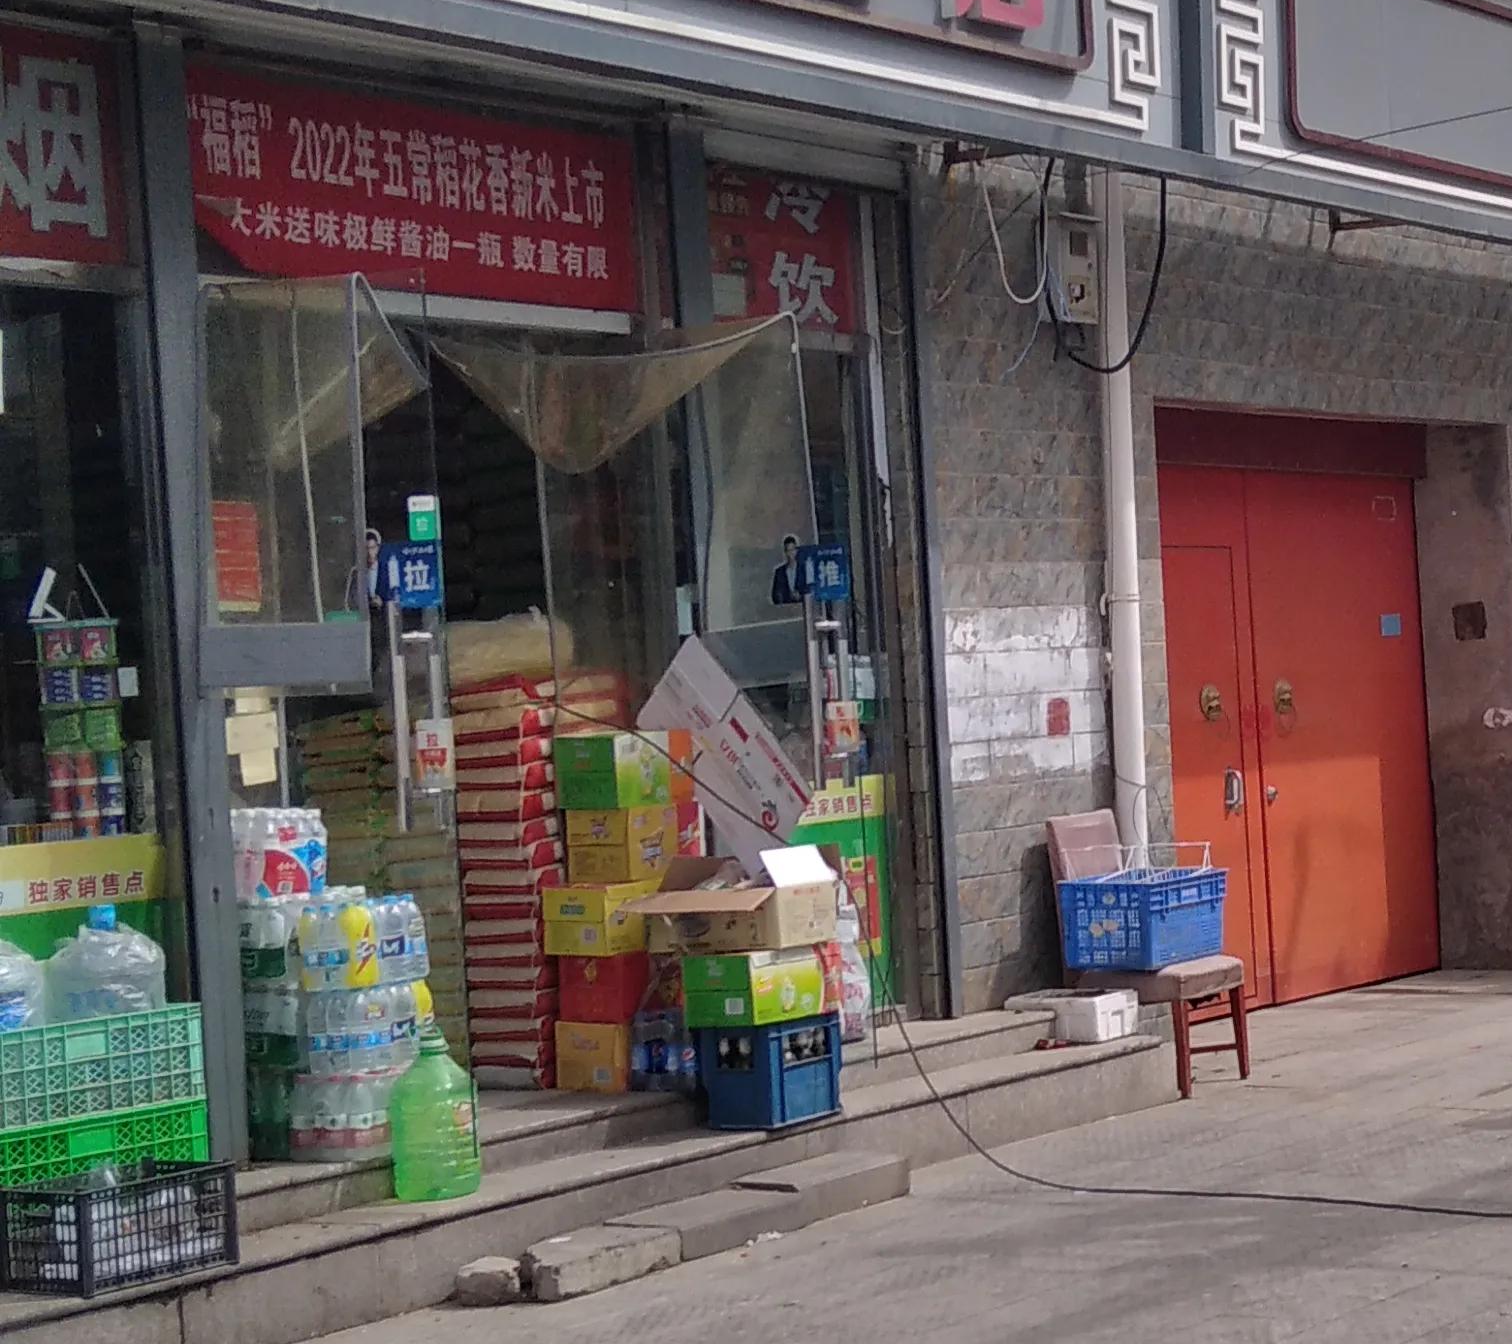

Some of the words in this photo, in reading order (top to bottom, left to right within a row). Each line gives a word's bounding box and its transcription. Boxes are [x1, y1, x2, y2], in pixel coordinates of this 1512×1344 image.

[0, 58, 107, 238] 烟
[288, 117, 604, 229] 2022年五常稻花香新米上市
[231, 197, 504, 268] 大米送味极鲜酱油一瓶
[512, 235, 608, 280] 数量有限
[403, 559, 430, 593] 拉
[818, 558, 840, 588] 推
[28, 871, 145, 905] 独家销售点
